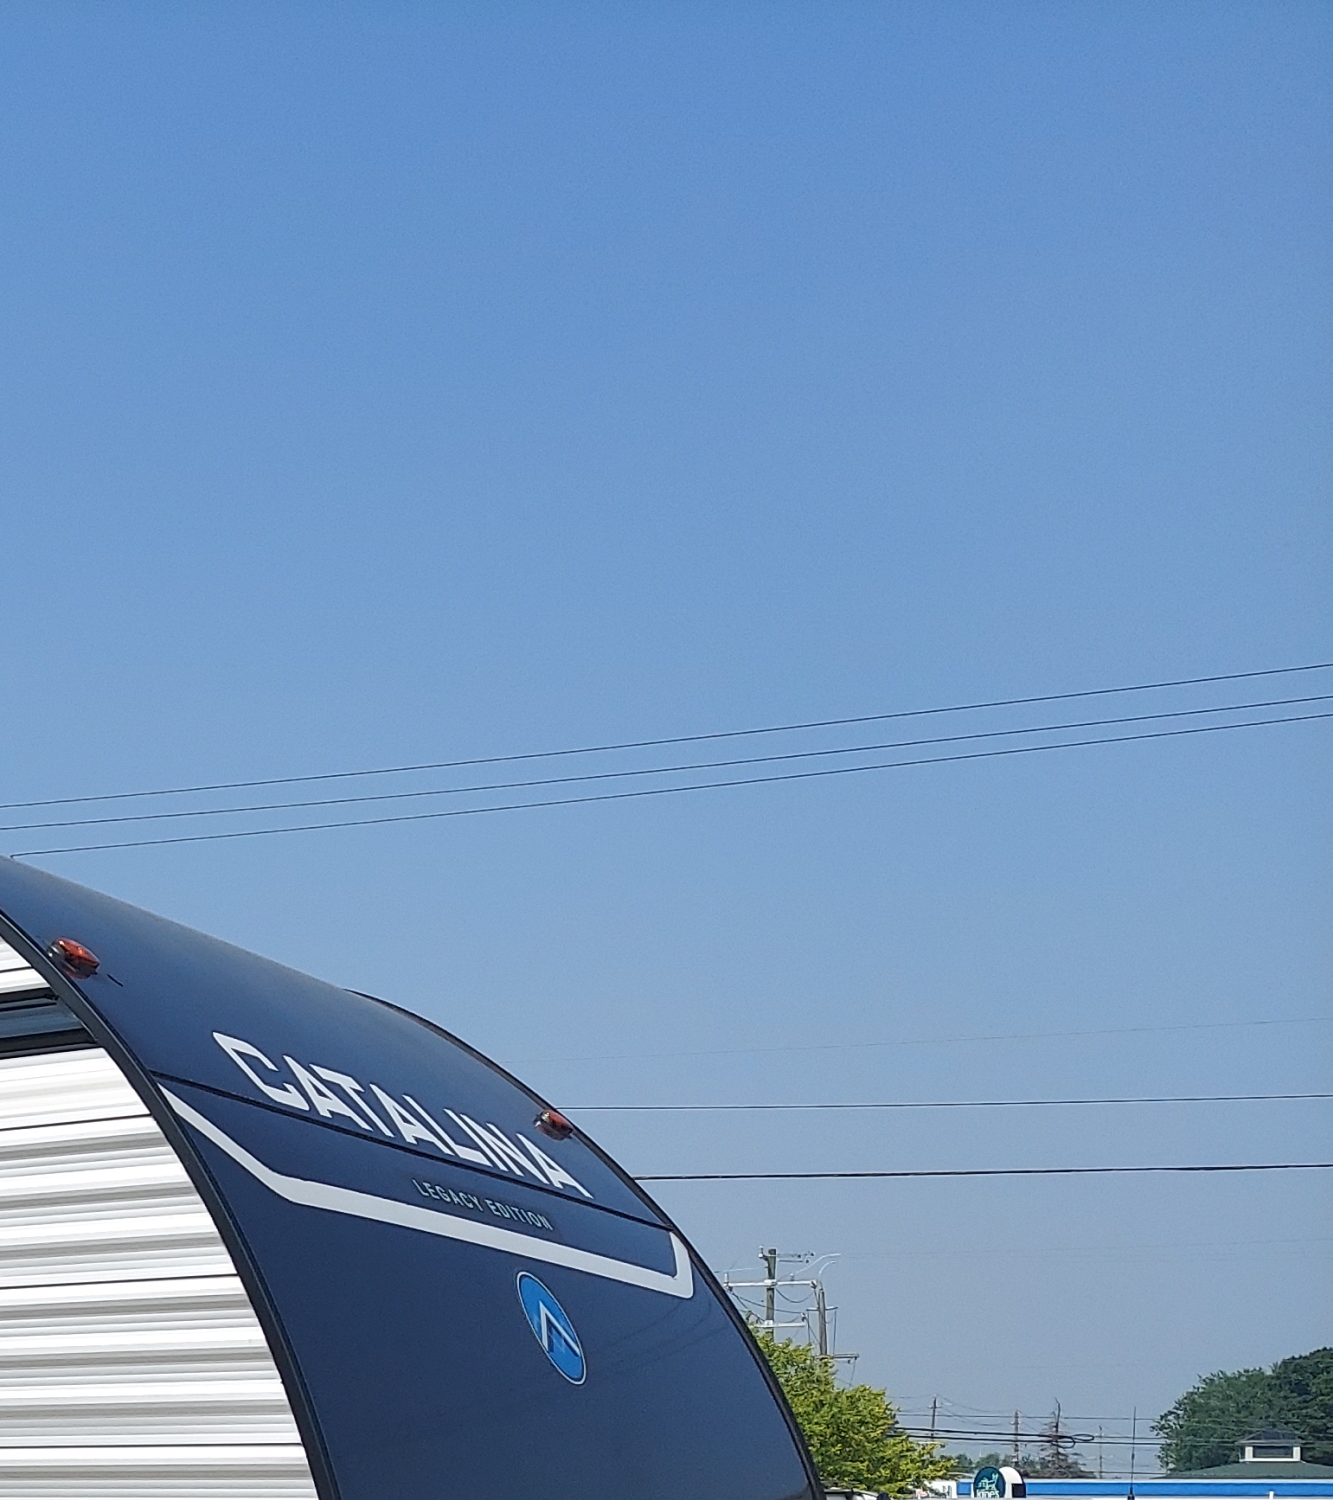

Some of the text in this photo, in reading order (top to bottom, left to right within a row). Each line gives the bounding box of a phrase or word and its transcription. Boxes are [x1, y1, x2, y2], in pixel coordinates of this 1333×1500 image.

[212, 1032, 594, 1199] CATALINA
[411, 1177, 555, 1232] LEGACY EDITION
